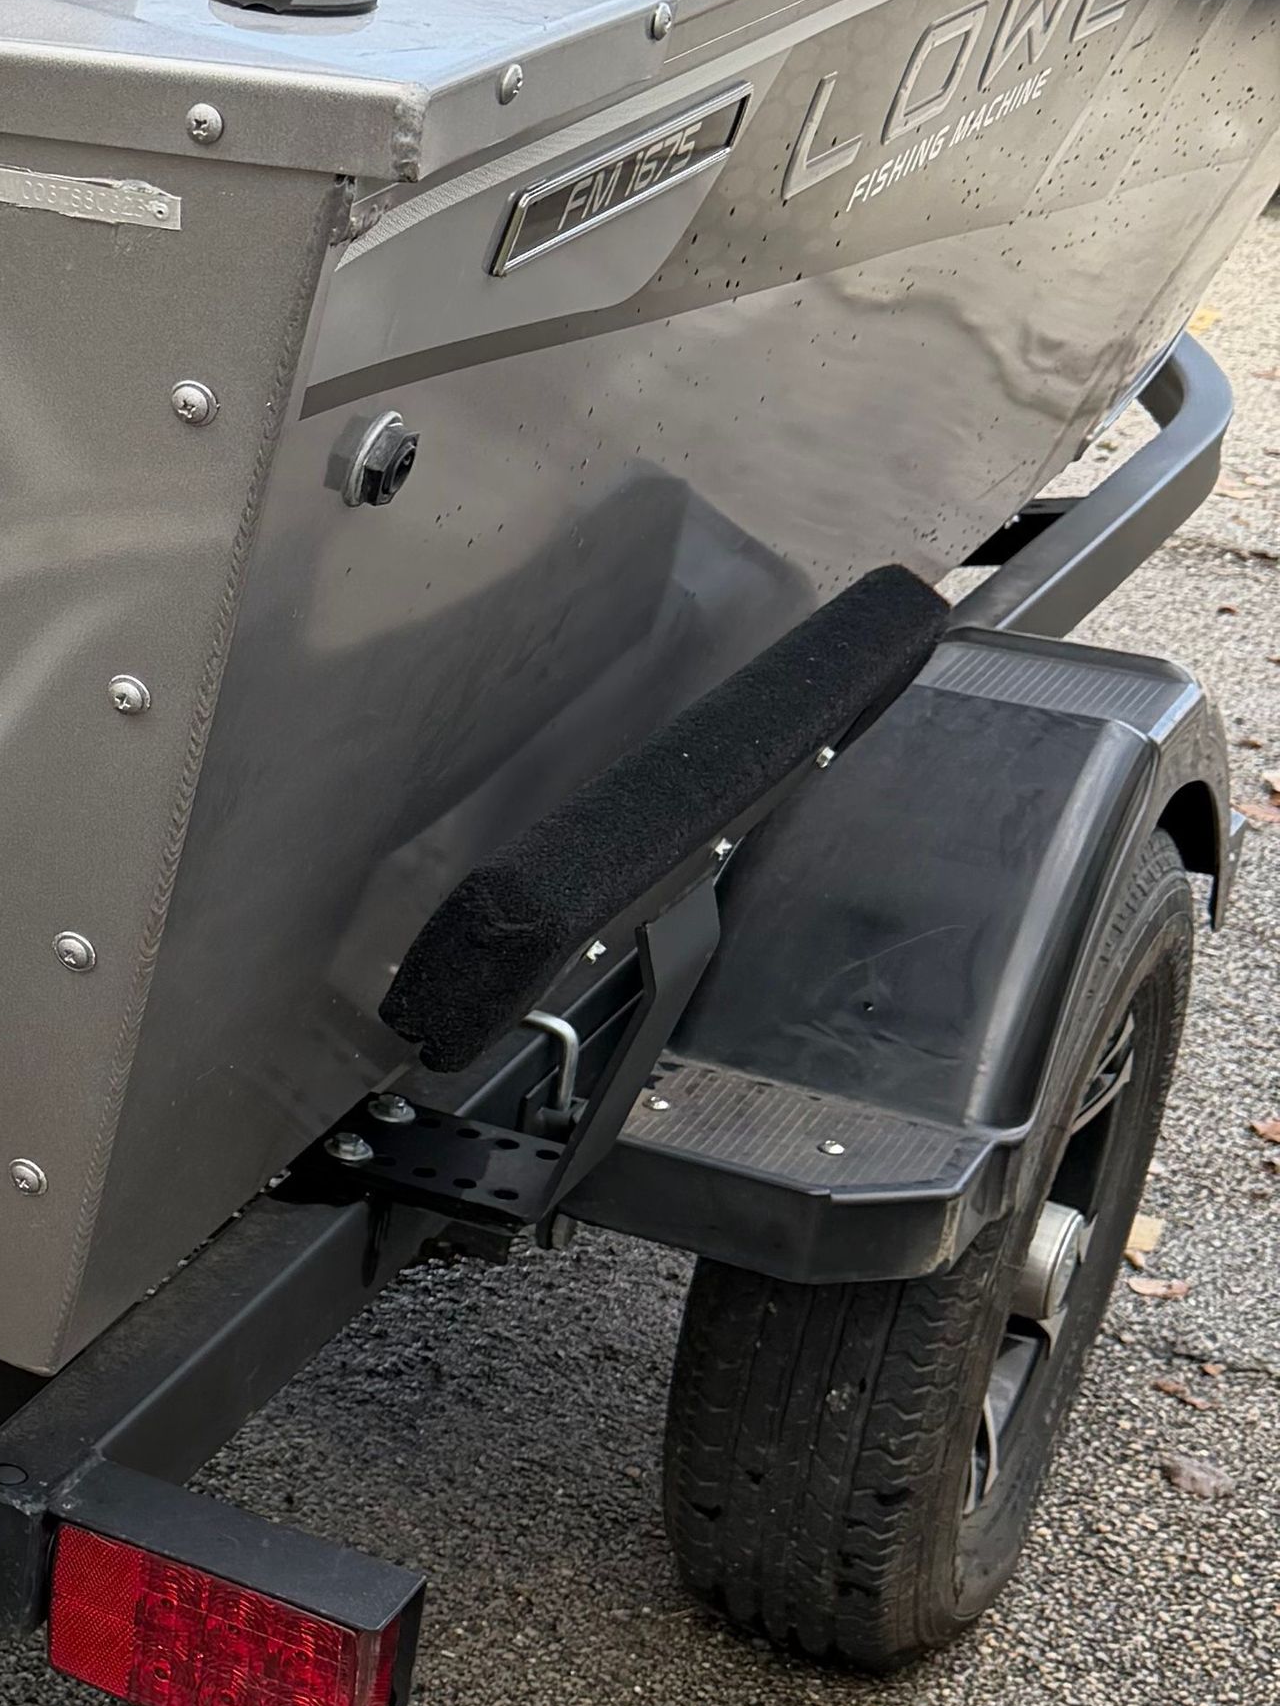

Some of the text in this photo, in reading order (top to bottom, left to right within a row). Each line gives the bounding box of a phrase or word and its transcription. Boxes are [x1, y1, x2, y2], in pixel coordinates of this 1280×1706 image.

[557, 121, 703, 231] FM 1675
[846, 67, 1053, 213] FISHING MACHINE
